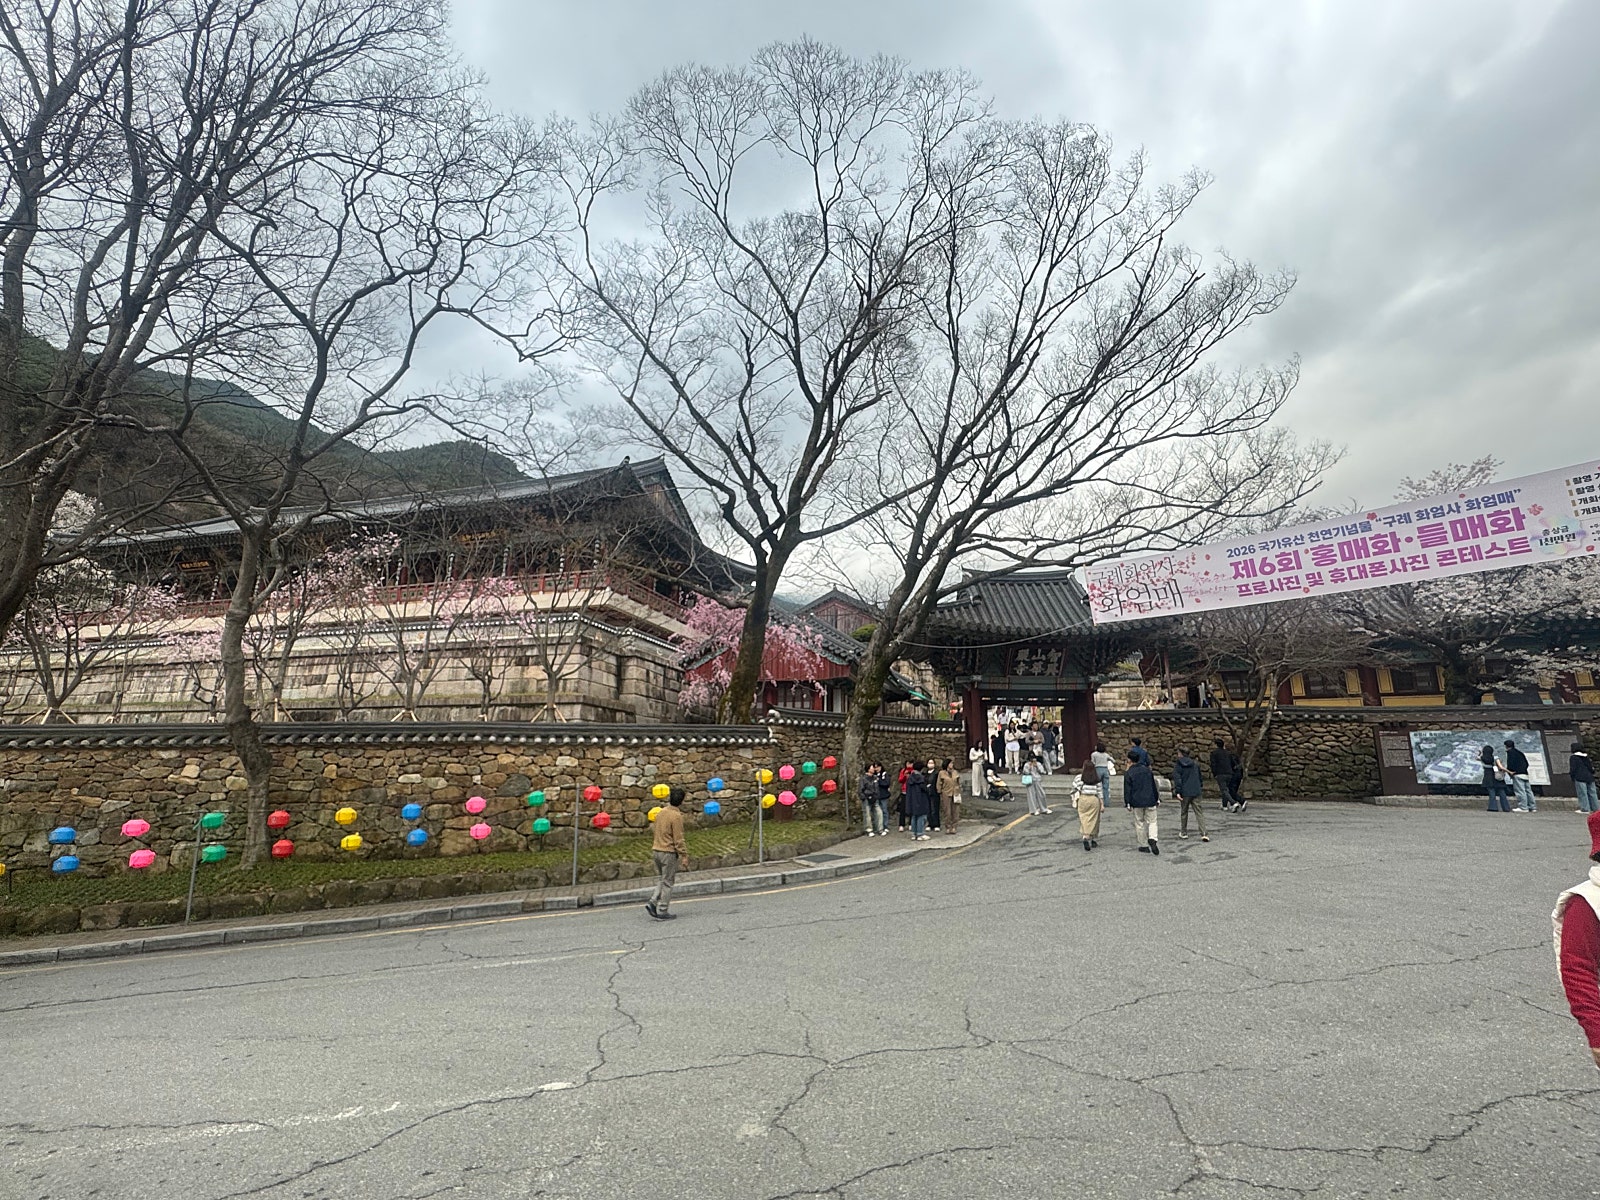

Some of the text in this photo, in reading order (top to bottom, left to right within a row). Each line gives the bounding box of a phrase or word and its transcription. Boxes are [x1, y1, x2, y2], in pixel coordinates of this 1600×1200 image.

[1226, 544, 1256, 558] 2026
[1259, 534, 1305, 552] 국가유산
[1307, 520, 1373, 543] 천연기념물
[1415, 502, 1461, 521] 화엄사
[1229, 550, 1303, 580] 제6회
[1236, 578, 1302, 597] 프로사진
[1305, 571, 1325, 587] 및
[1329, 554, 1430, 584] 휴대폰사진
[1436, 536, 1532, 567] 콘테스트
[1099, 578, 1185, 616] 화엄매
